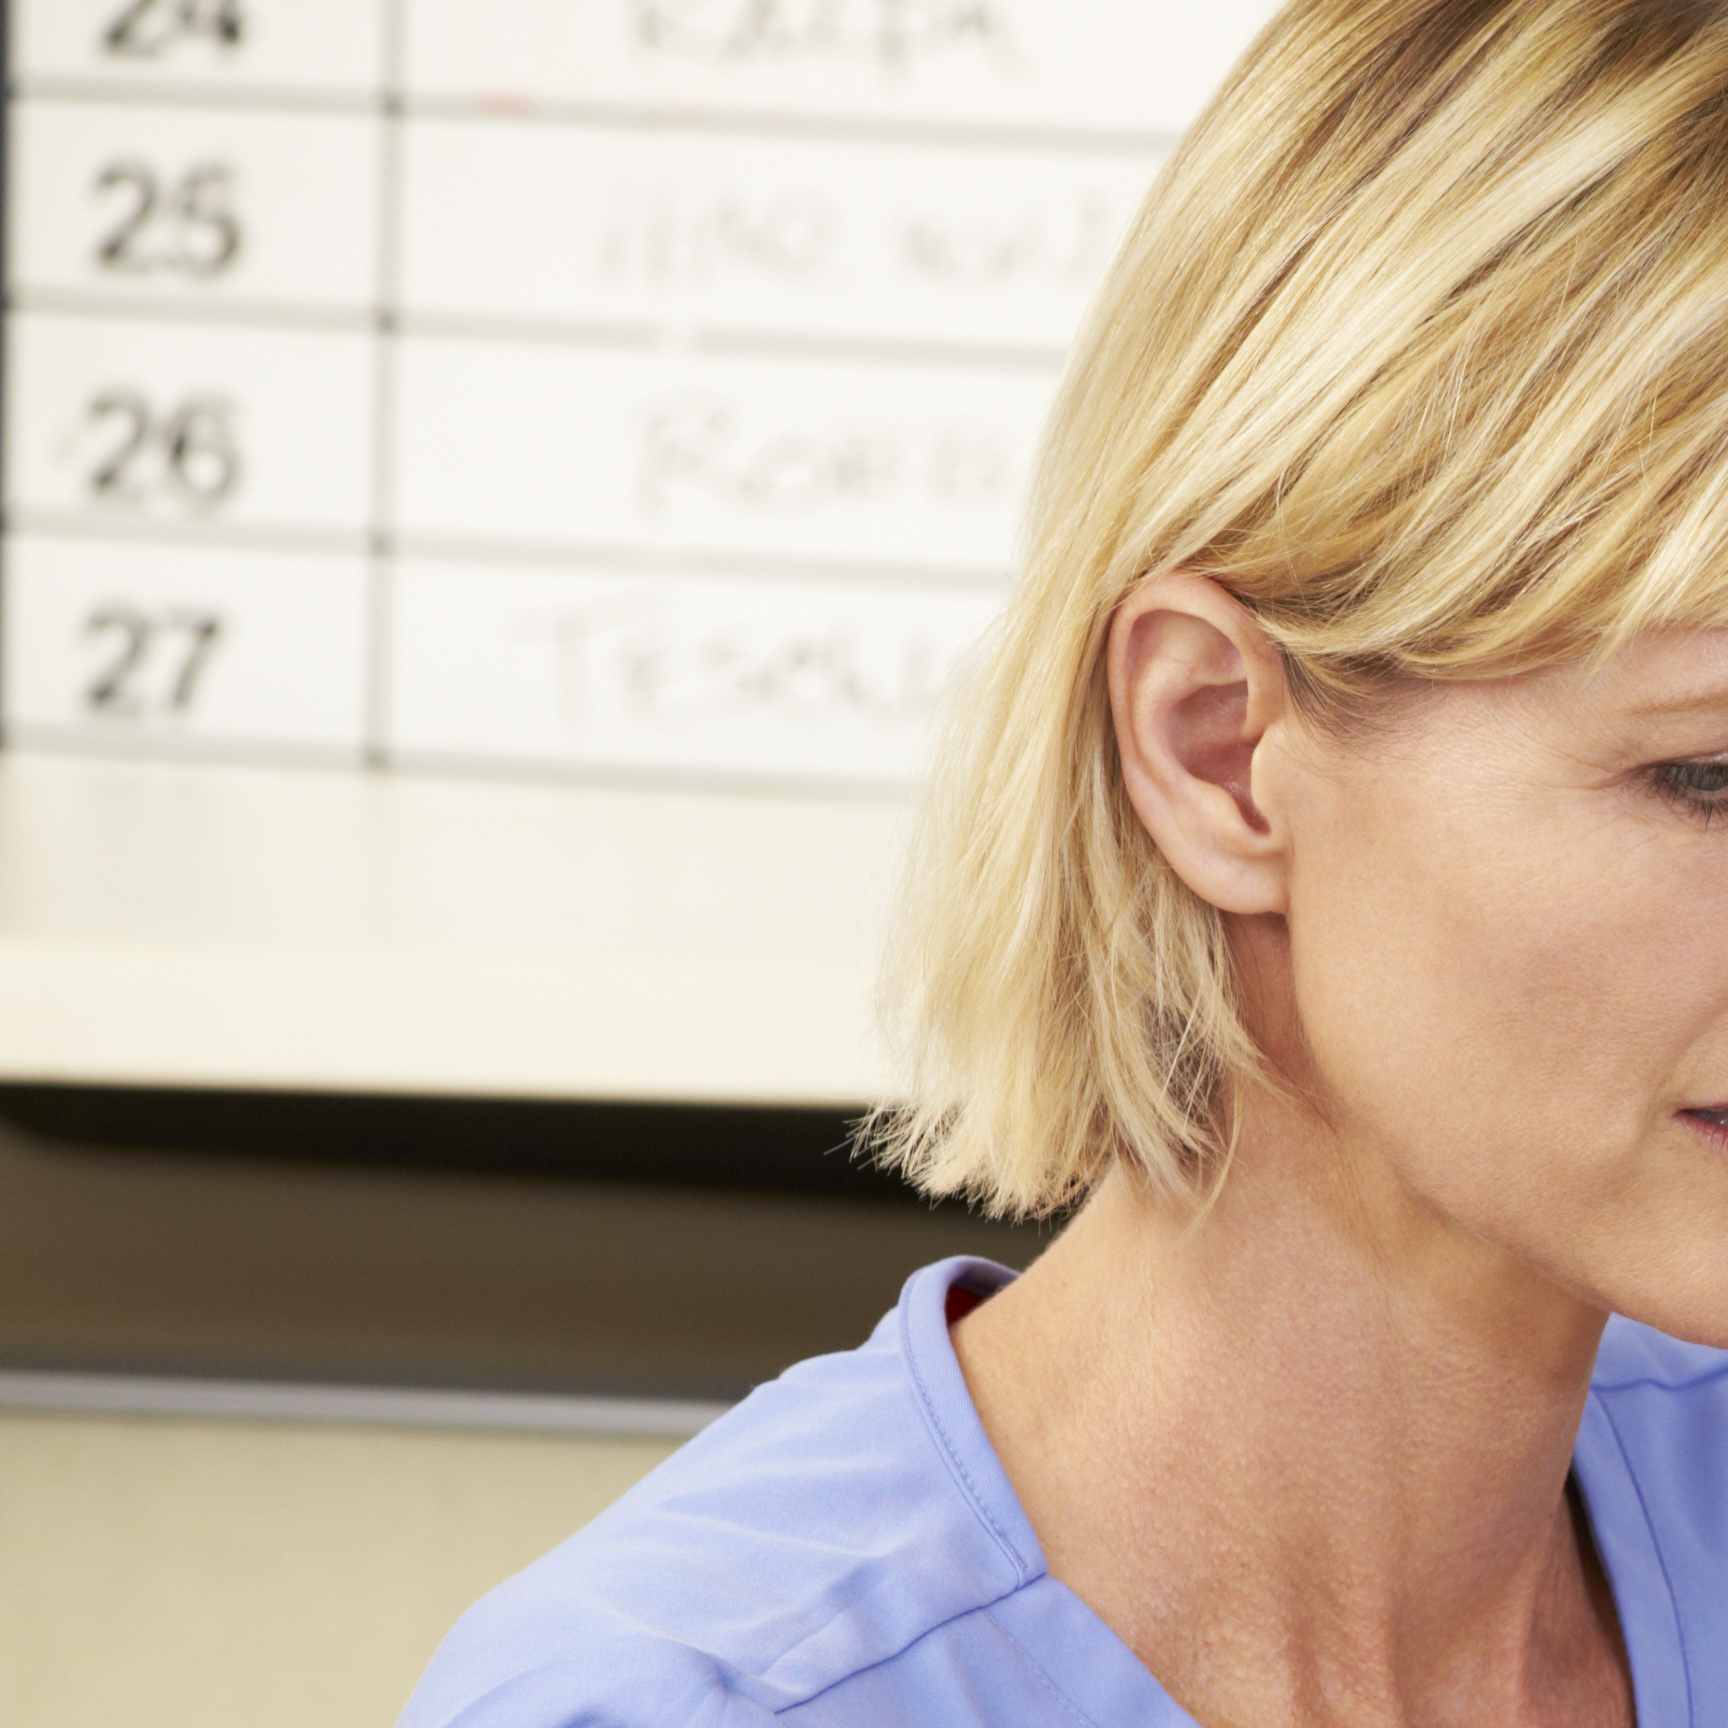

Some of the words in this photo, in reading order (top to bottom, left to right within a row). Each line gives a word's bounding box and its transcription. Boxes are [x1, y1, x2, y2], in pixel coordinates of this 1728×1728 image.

[93, 162, 243, 278] 25
[86, 392, 239, 514] 26
[82, 607, 222, 717] 27
